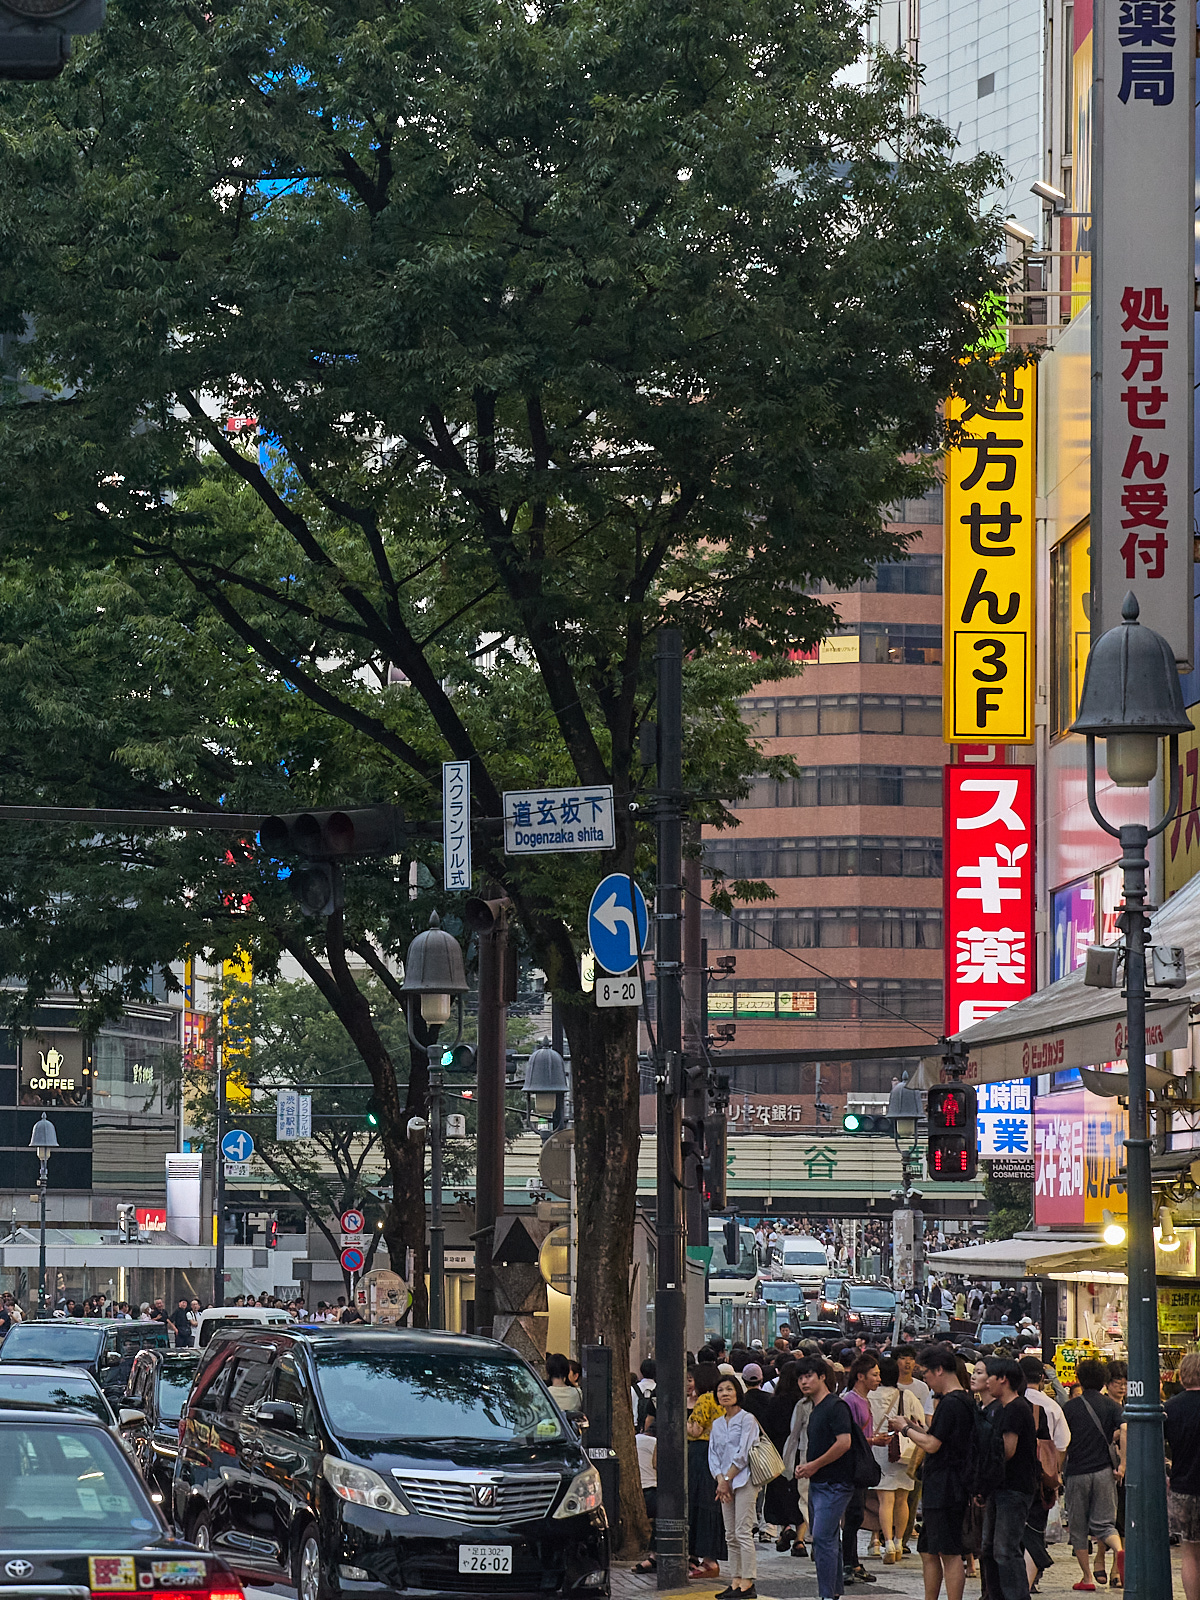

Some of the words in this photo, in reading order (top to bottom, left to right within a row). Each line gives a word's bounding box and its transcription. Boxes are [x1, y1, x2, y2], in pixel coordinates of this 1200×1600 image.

[1120, 286, 1170, 580] 処方せん受付
[972, 638, 1008, 728] 3F
[512, 795, 604, 828] 道玄坂下
[449, 767, 465, 886] スクランブル式
[515, 828, 574, 848] Dogenzaka
[577, 826, 604, 842] shita
[1031, 1038, 1065, 1071] ビックカメラ
[29, 1077, 75, 1091] COFFEE
[285, 1095, 296, 1137] 渋谷駅前
[729, 1104, 802, 1122] りそな銀行
[1035, 1114, 1084, 1198] スギ薬局
[992, 1171, 1035, 1179] COSMETICS
[471, 1557, 509, 1571] 26-02
[472, 1547, 486, 1556] 足立
[487, 1548, 501, 1556] 302
[159, 1575, 204, 1586] CROWN
